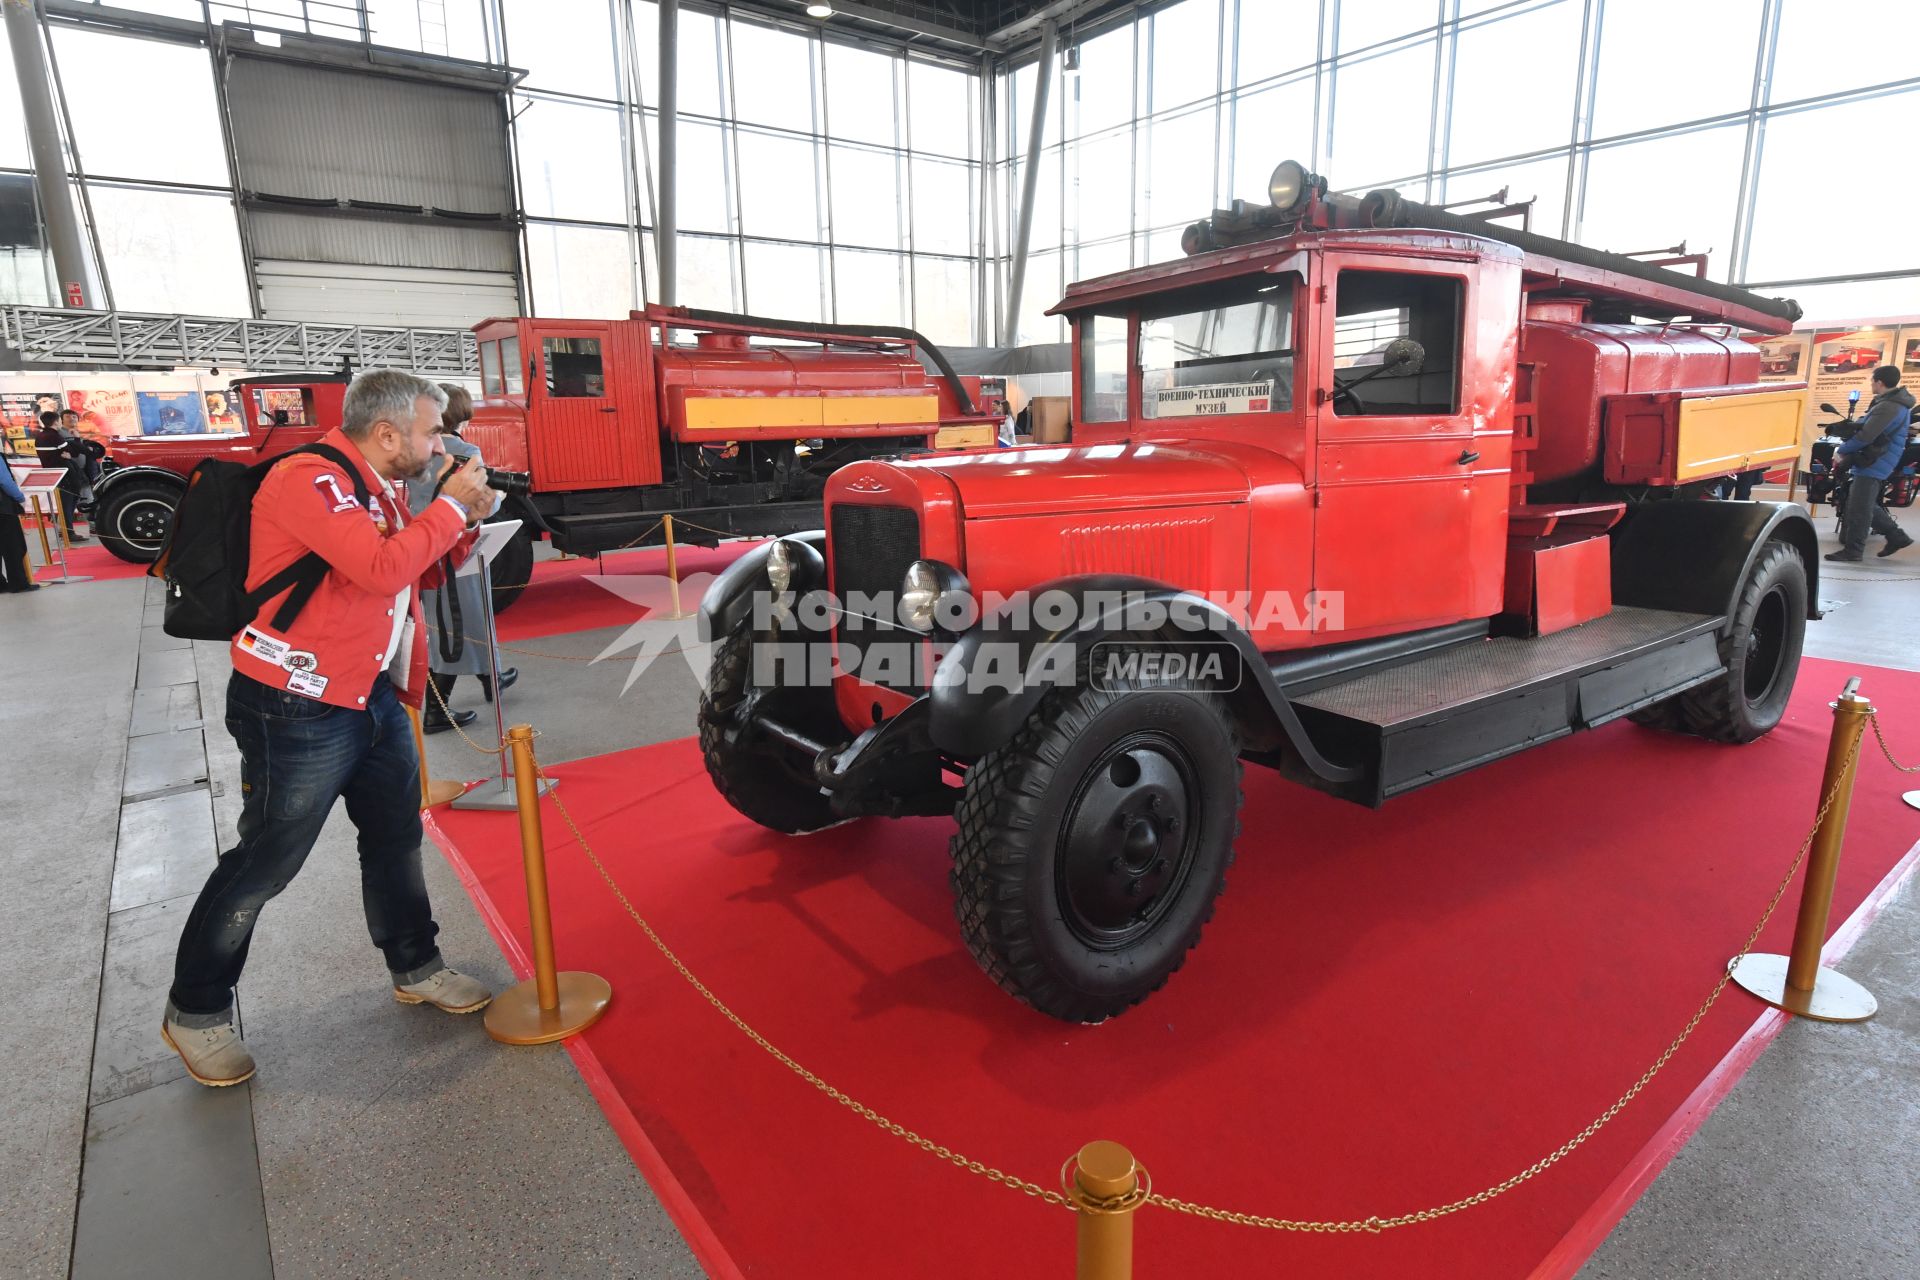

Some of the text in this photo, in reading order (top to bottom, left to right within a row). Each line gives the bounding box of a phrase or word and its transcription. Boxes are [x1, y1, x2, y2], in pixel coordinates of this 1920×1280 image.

[1158, 383, 1270, 402] ВОЕННО-ТЕХНИЧЕСКИЙ
[105, 405, 133, 416] ПОЖАР
[1195, 401, 1227, 414] МУЗЕЙ
